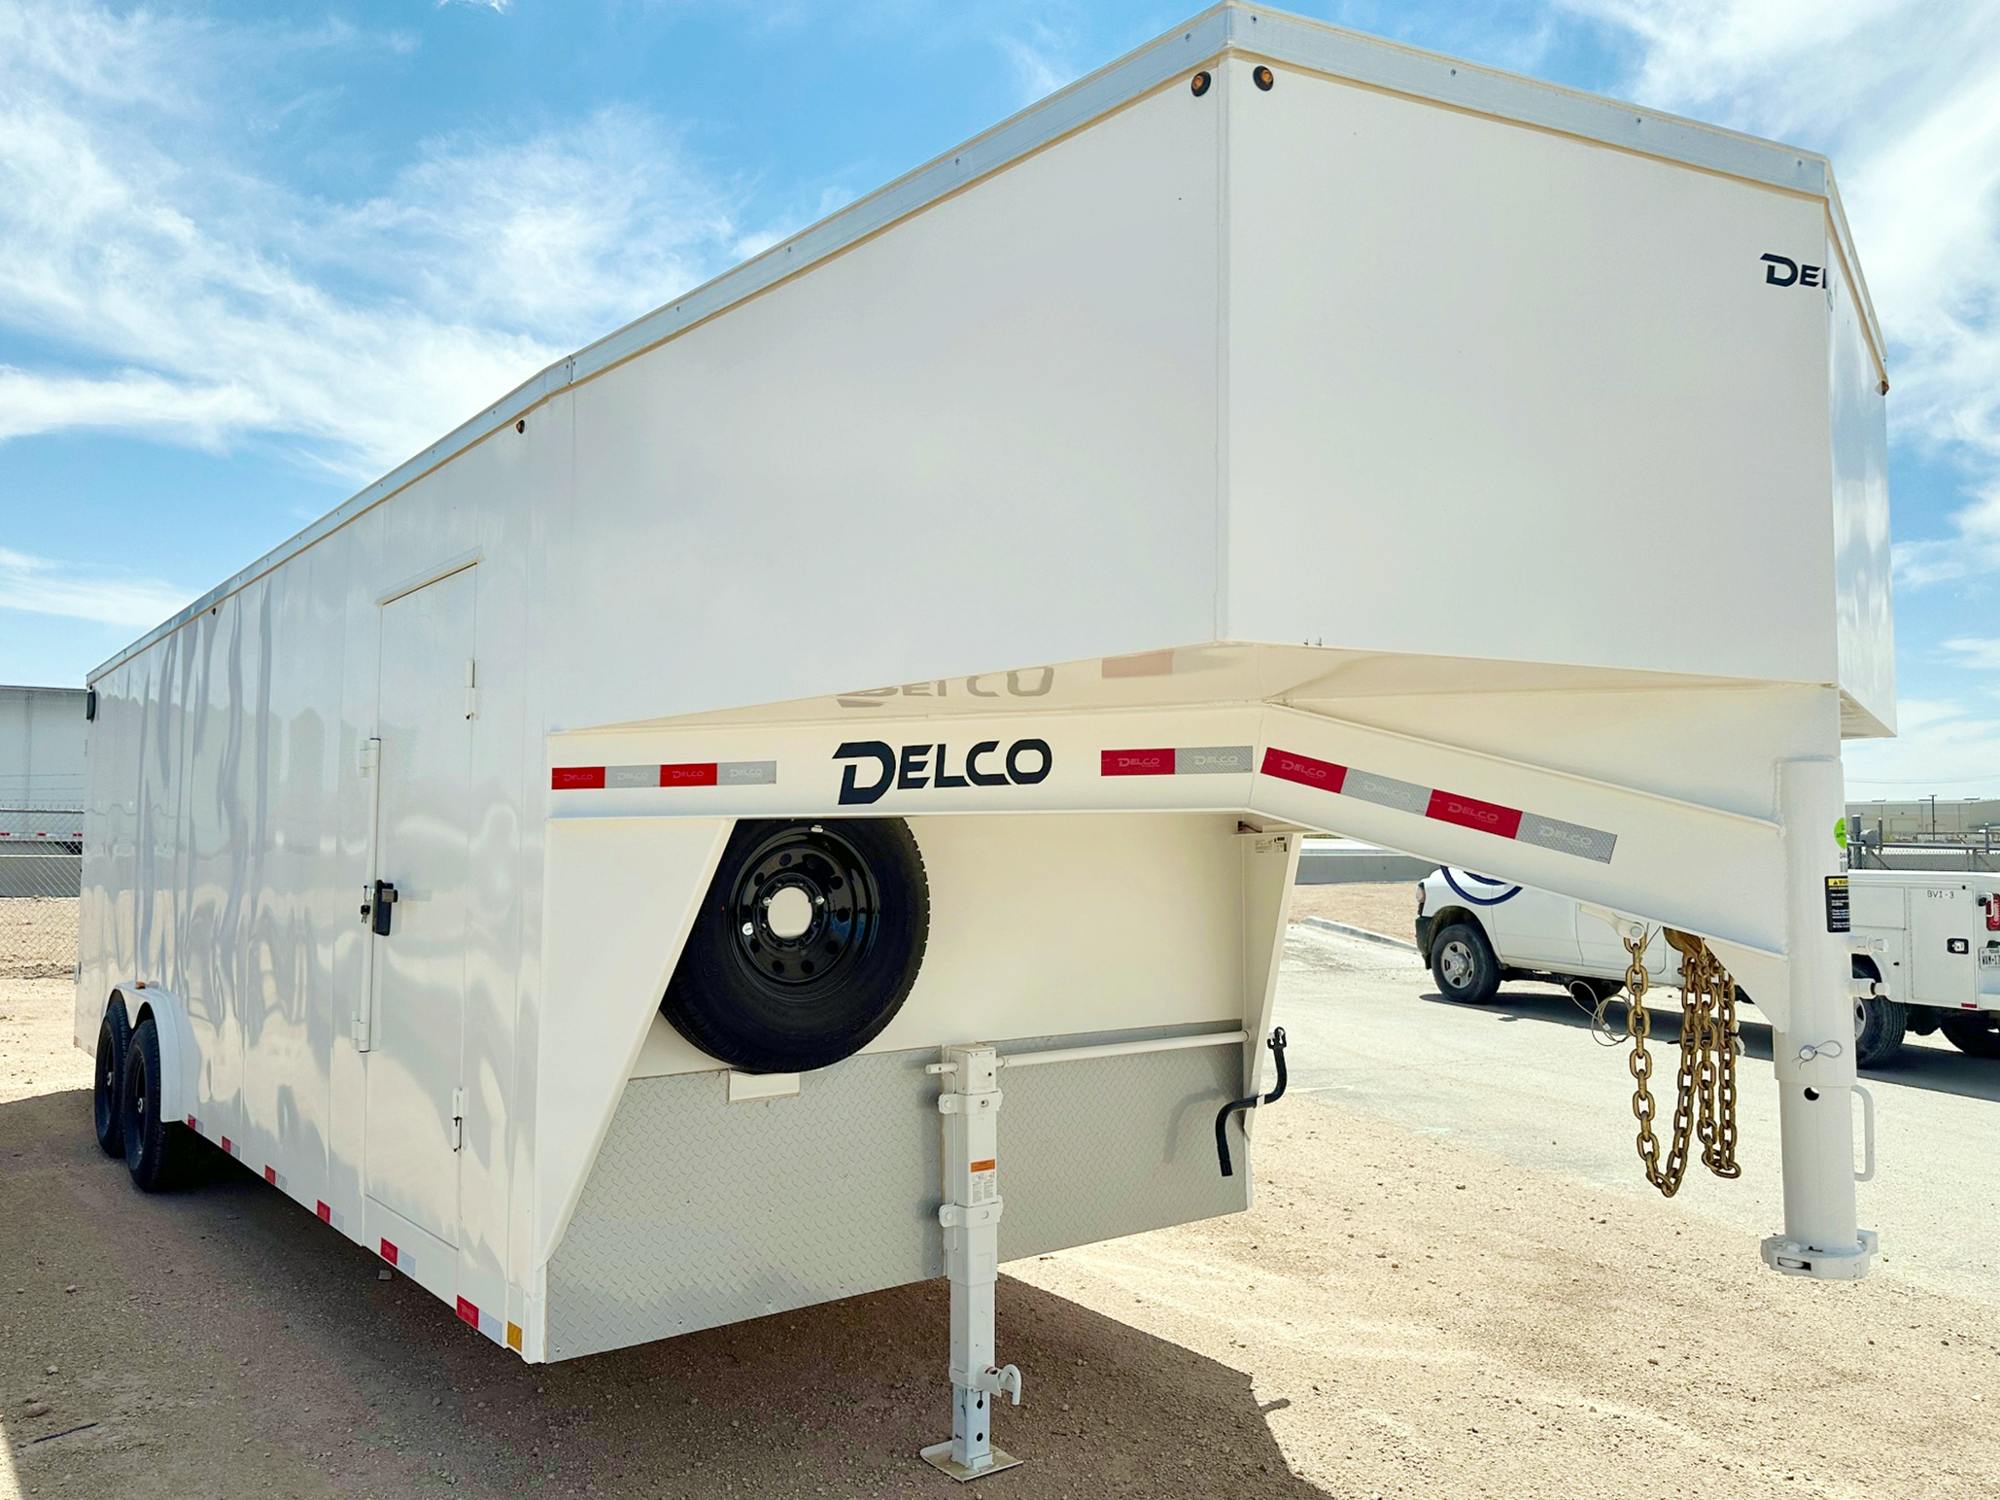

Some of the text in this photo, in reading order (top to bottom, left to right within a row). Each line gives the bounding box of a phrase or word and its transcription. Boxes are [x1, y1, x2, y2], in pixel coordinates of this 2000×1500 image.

[832, 739, 1052, 805] DELCO
[1118, 758, 1160, 767] DELCO
[1280, 759, 1327, 778] DELCO
[672, 770, 704, 779] DELCO
[1447, 802, 1499, 822] DELCO
[1539, 825, 1593, 846] DELCO
